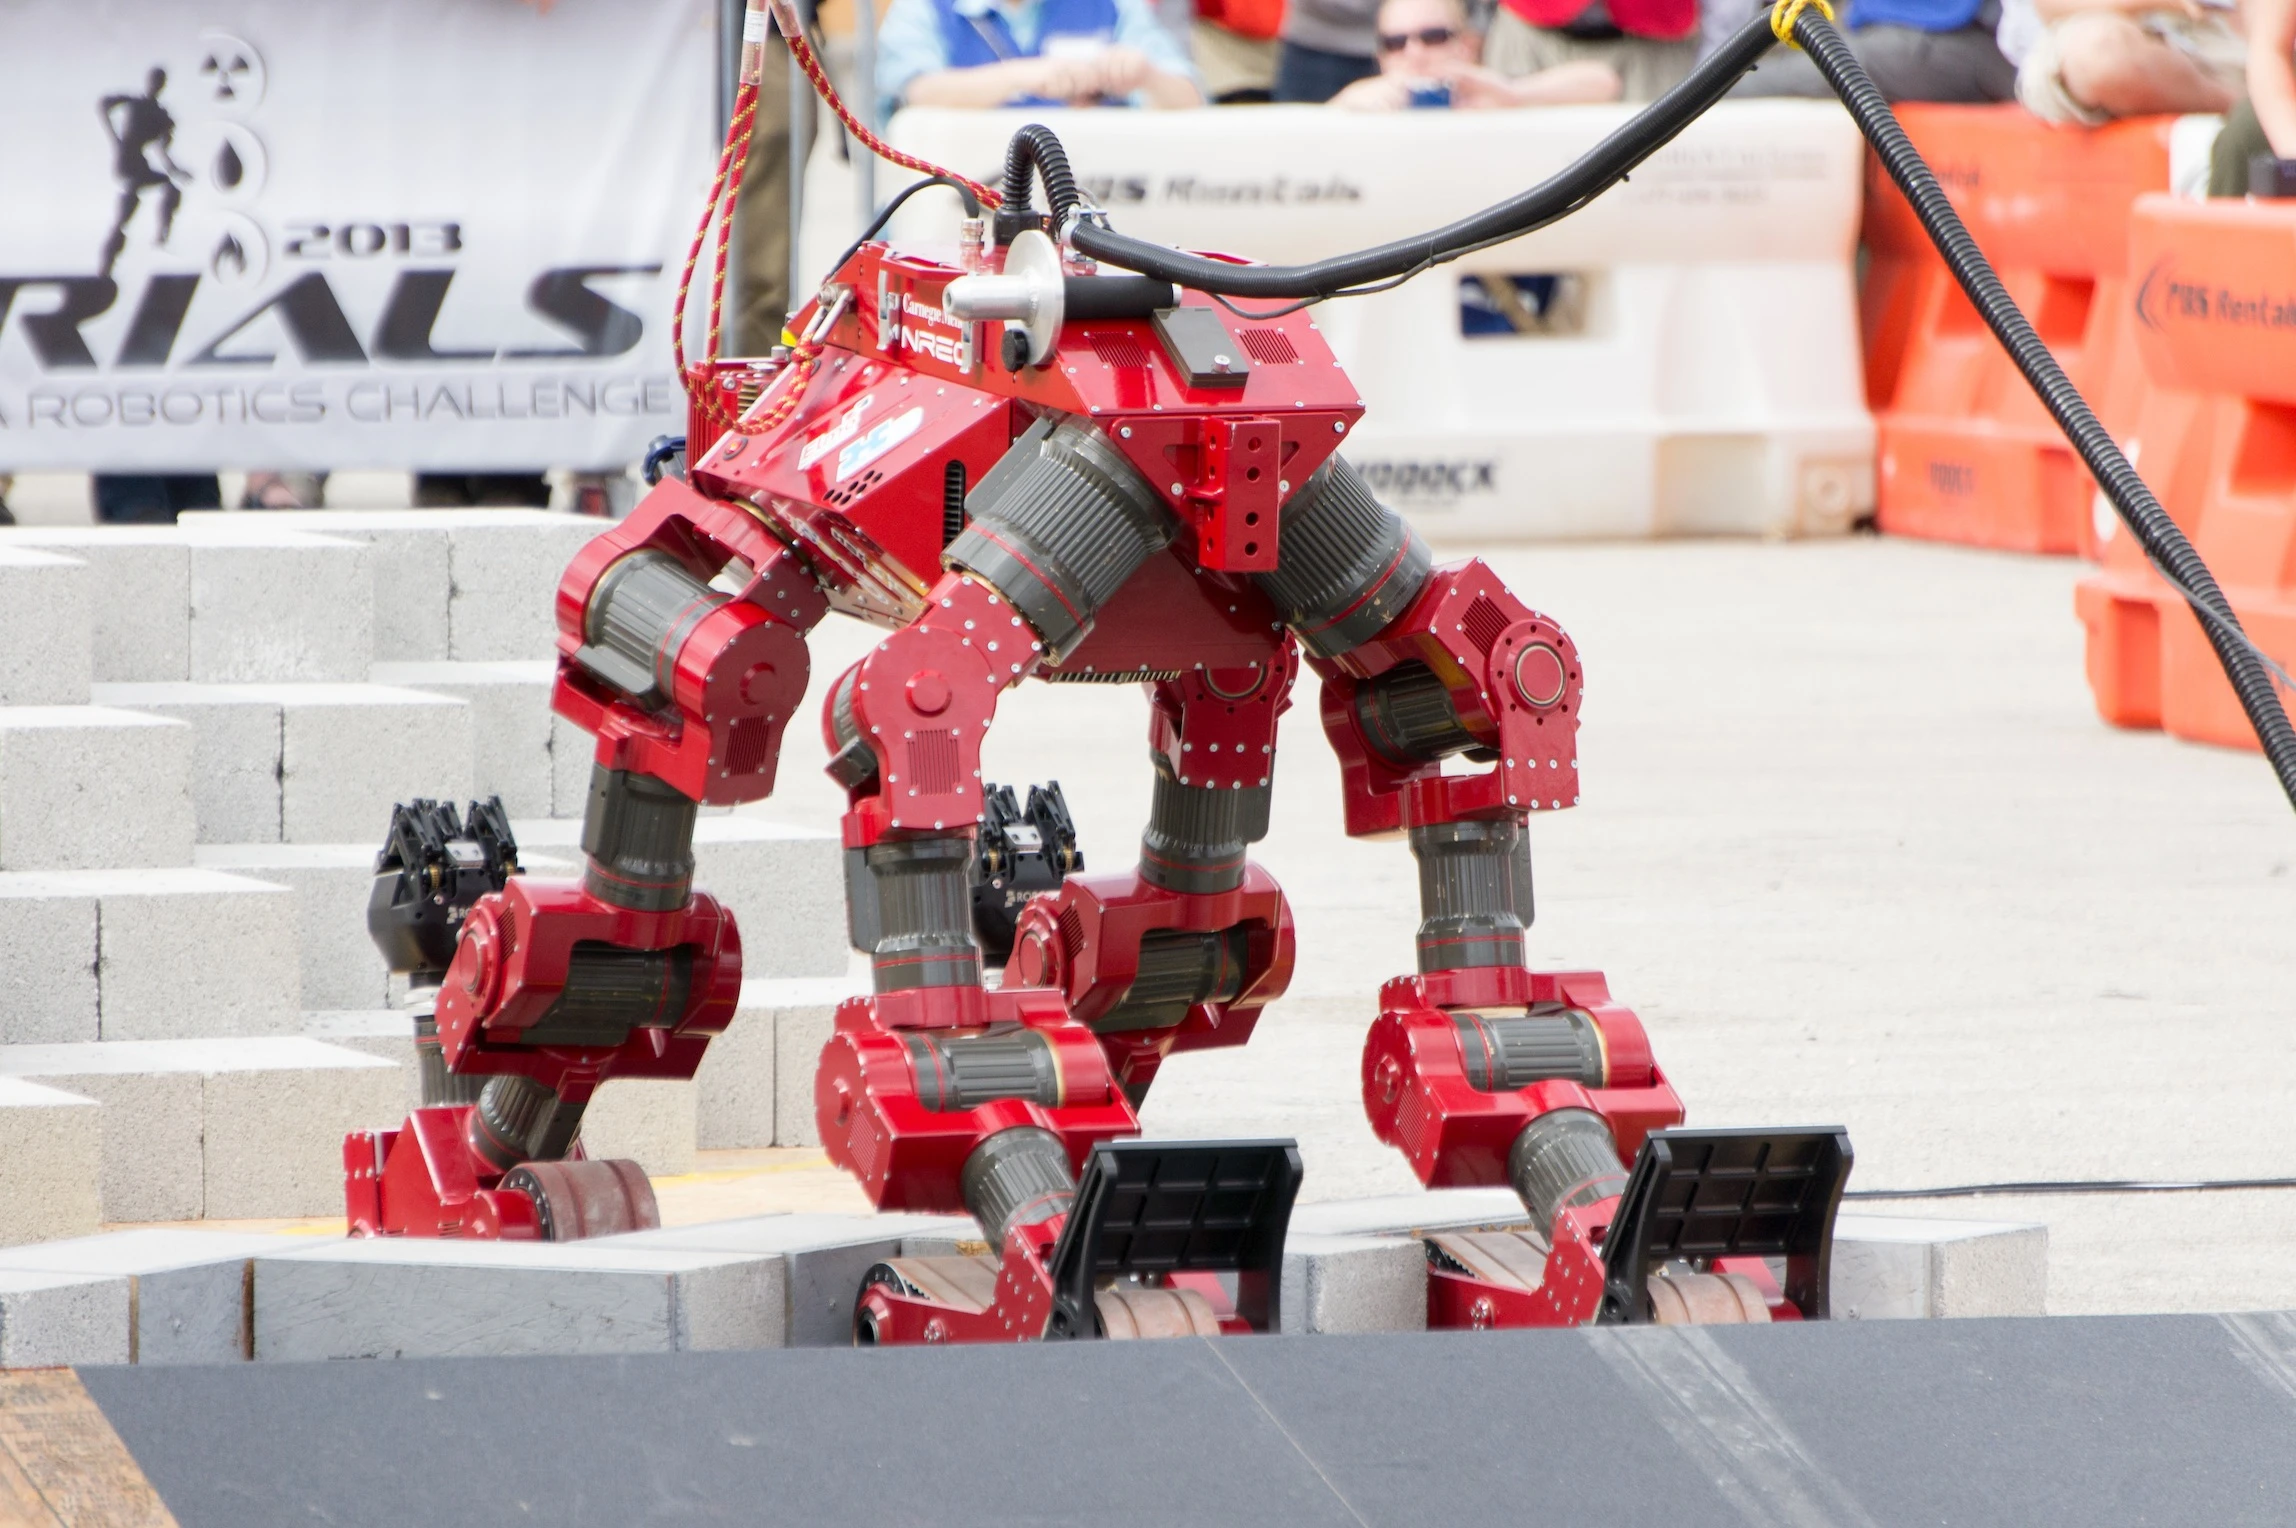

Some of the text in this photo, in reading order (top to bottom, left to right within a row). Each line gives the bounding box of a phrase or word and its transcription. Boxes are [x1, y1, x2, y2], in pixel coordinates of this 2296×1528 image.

[283, 223, 463, 258] 2013
[902, 292, 942, 327] Carnegie
[27, 383, 328, 428] ROBOTICS
[346, 378, 673, 422] CHALLENGE
